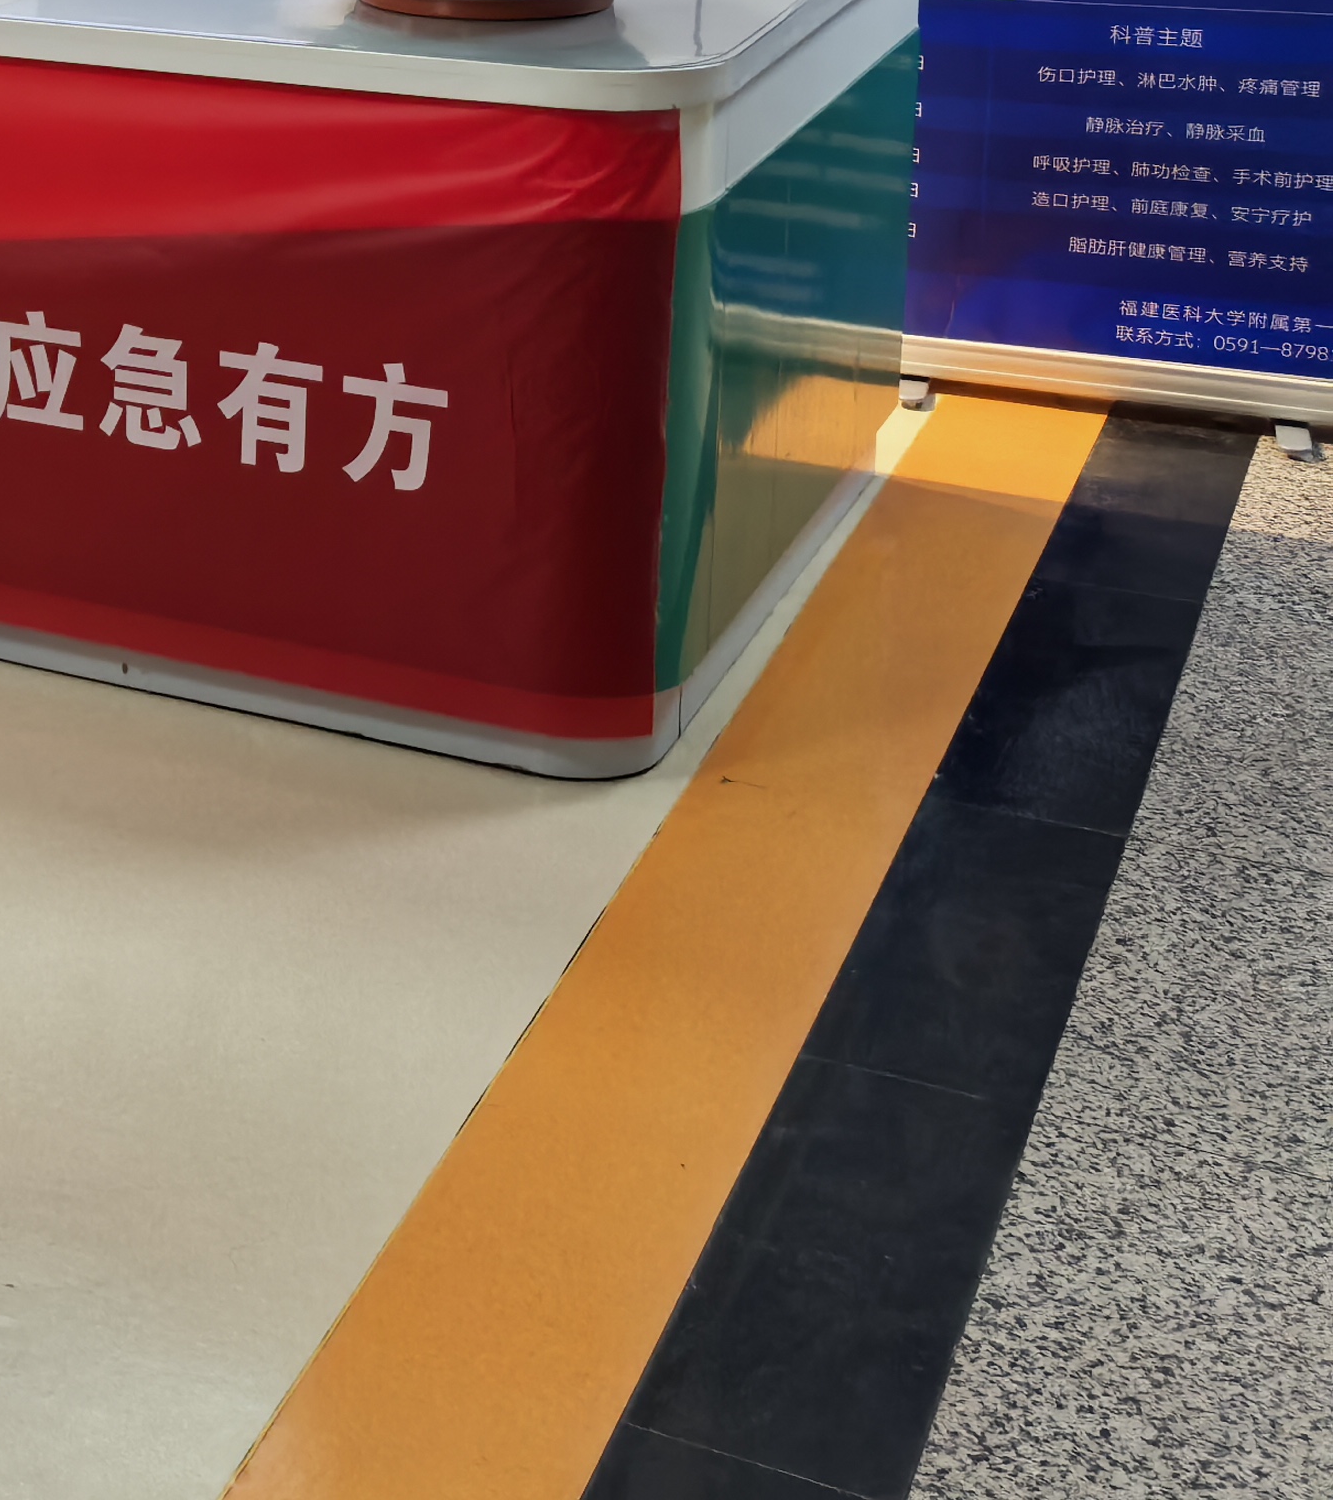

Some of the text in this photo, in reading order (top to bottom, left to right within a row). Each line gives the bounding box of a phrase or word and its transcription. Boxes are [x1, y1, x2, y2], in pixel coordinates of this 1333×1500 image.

[1110, 24, 1203, 49] 科普主题
[1037, 66, 1321, 99] 伤口护理、淋巴水肿、疼痛管理
[1086, 116, 1266, 144] 静脉治疗、静脉采血
[1032, 191, 1312, 227] 造口护理、前庭康复、安宁疗护
[1068, 236, 1309, 274] 脂肪肝健康管理、营养支持
[1118, 299, 1333, 335] 福建医科大学附属第一
[1116, 324, 1333, 363] 联系方式：0591—8798
